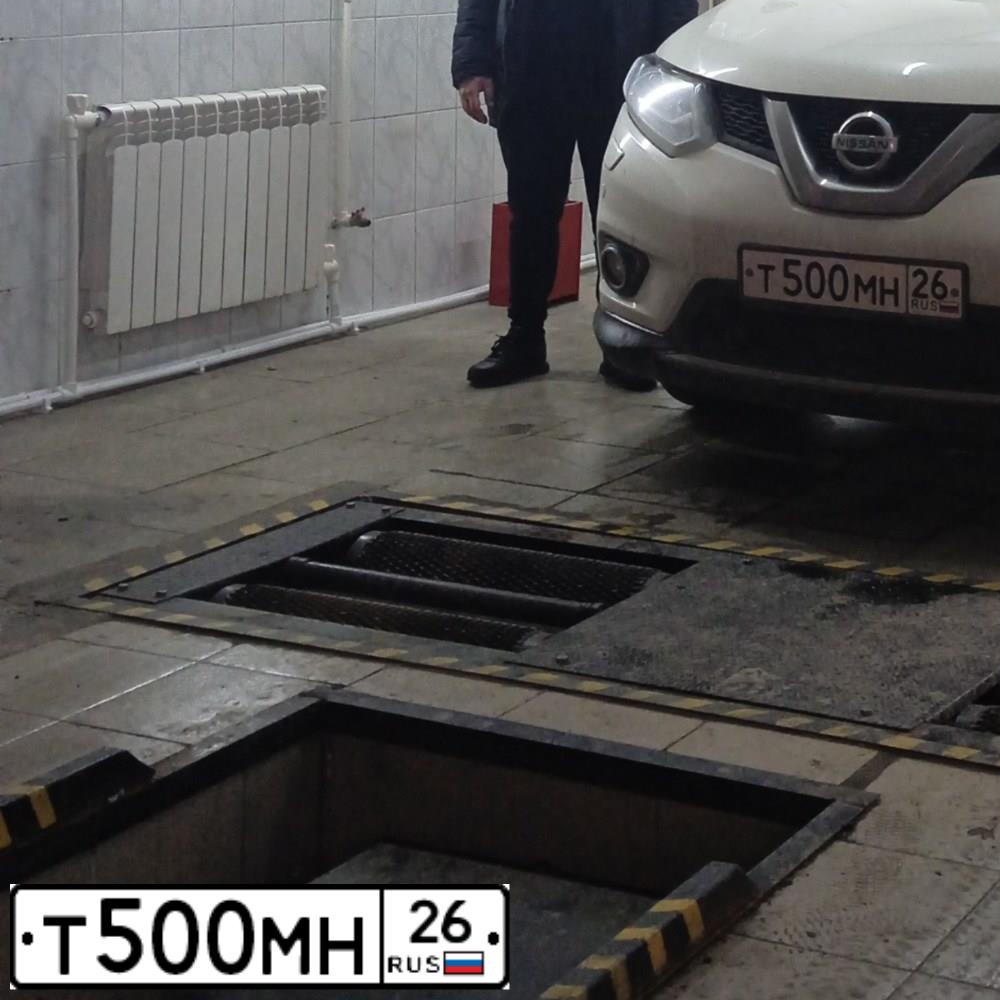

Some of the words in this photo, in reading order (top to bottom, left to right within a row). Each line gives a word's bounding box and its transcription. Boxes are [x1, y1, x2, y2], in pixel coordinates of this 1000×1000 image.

[836, 138, 888, 149] NISSAN
[757, 258, 899, 307] Т500МН
[911, 268, 948, 299] 26
[911, 299, 938, 312] RUS
